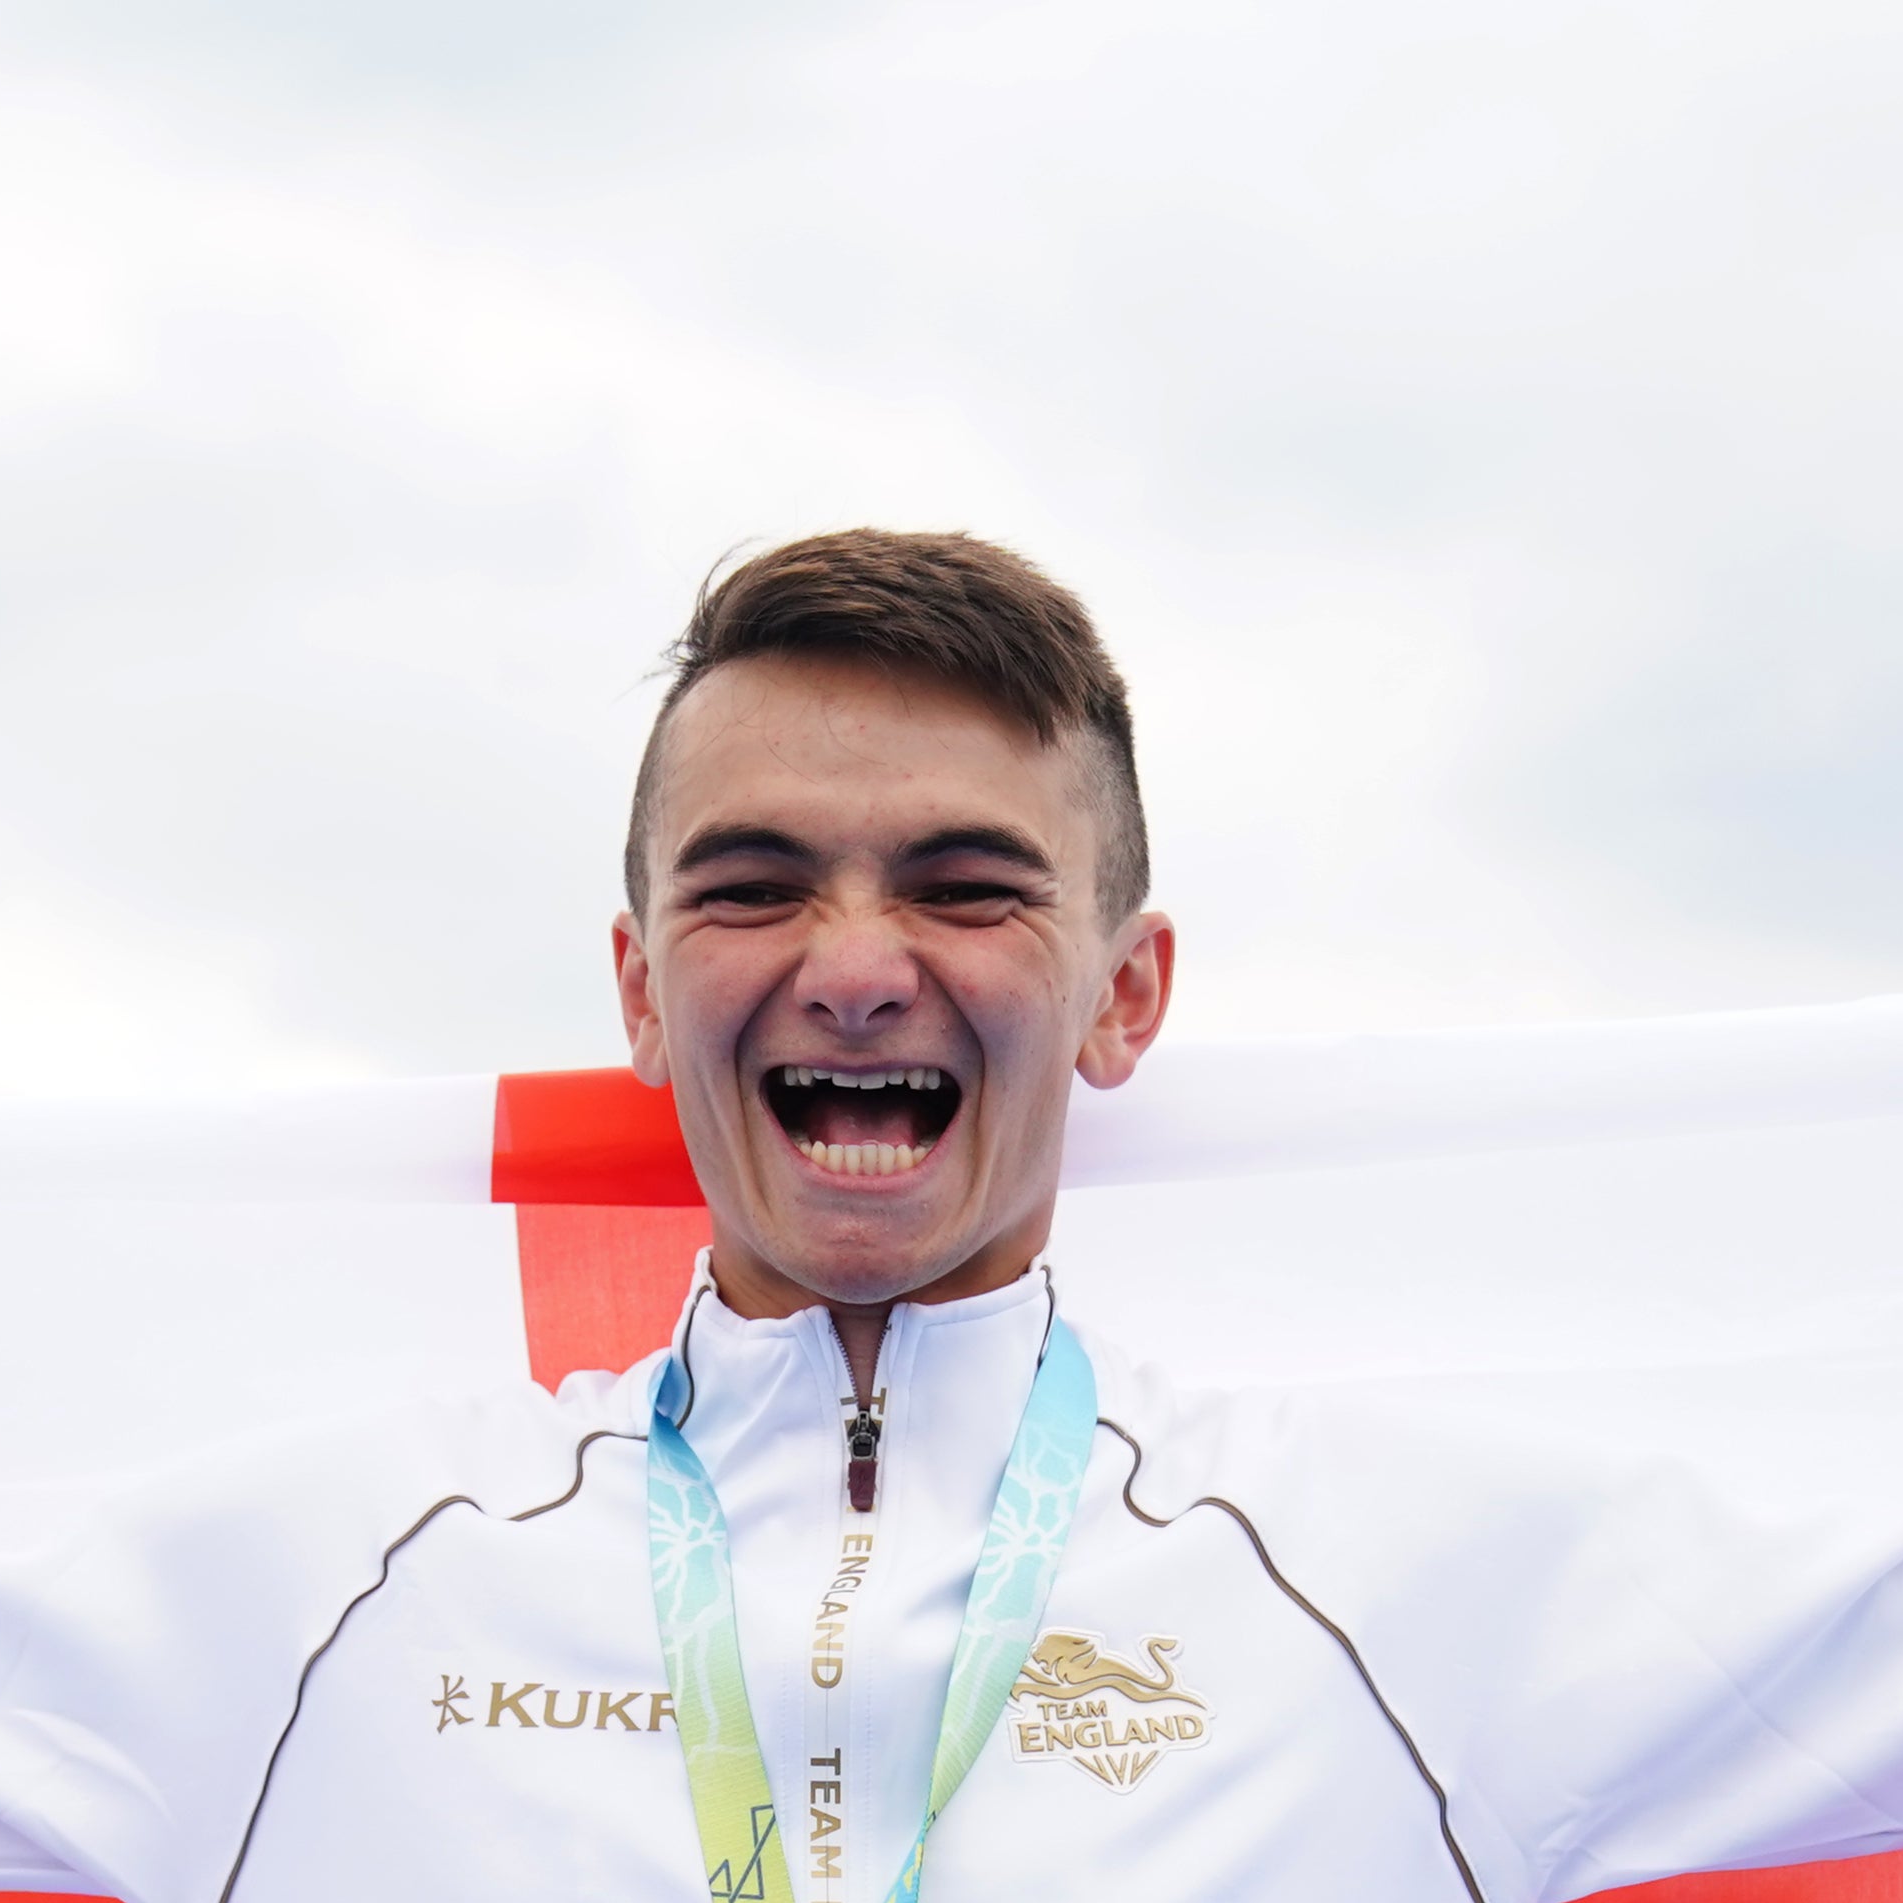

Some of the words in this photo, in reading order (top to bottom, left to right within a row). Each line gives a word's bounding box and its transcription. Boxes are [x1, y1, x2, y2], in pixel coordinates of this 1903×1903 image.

[811, 1534, 874, 1689] ENGLAND
[485, 1681, 679, 1732] KUKR
[1038, 1700, 1107, 1722] TEAM
[1017, 1714, 1204, 1753] ENGLAND
[810, 1748, 842, 1879] TEAM
